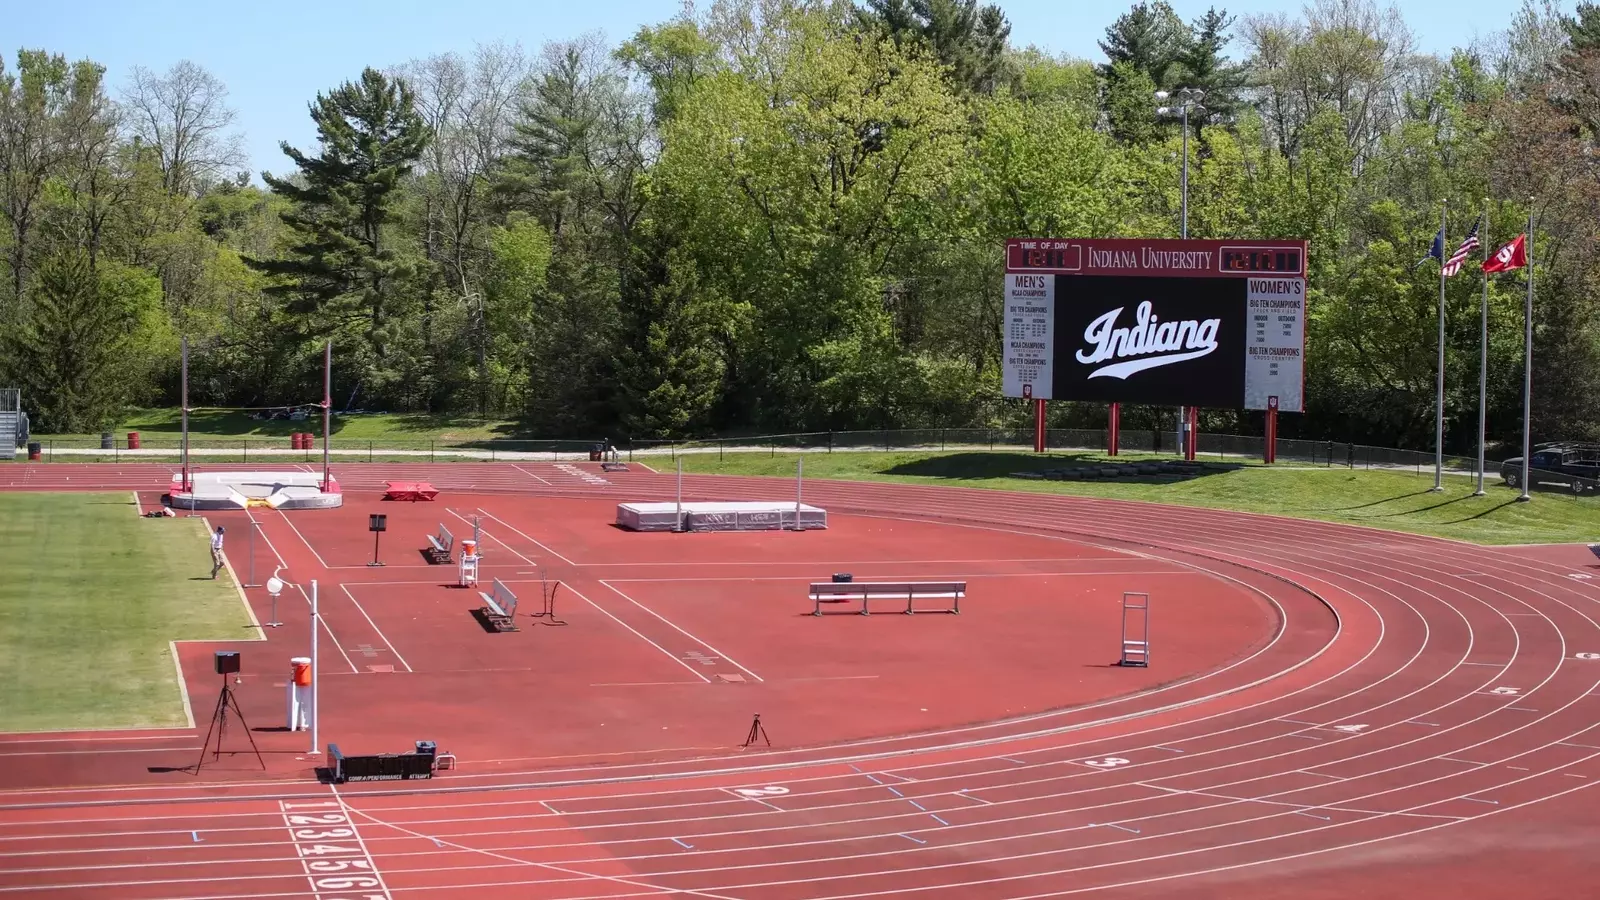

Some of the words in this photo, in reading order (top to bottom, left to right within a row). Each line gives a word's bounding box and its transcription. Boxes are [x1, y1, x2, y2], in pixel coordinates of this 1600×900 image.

[1020, 242, 1037, 250] TIME
[1041, 242, 1051, 250] OF
[1054, 242, 1069, 250] DAY
[1087, 246, 1138, 269] INDIANA
[1141, 246, 1213, 270] UNIVERSITY
[1015, 275, 1045, 288] MEN'S
[1250, 280, 1301, 295] WOMEN'S
[1250, 300, 1259, 308] BIG
[1260, 300, 1270, 308] TEN
[1270, 300, 1301, 309] CHAMPIONS
[1075, 300, 1221, 365] Indiana
[1022, 341, 1046, 350] CHAMPIONS
[1249, 346, 1258, 355] BIG
[1258, 347, 1269, 355] TEN
[1269, 347, 1300, 357] CHAMPIONS
[1024, 358, 1047, 366] CHAMPIONS
[1489, 686, 1522, 695] 5
[1084, 757, 1131, 767] 3
[734, 786, 790, 797] 2
[285, 801, 340, 810] 1
[288, 814, 347, 825] 2
[295, 828, 354, 839] 3
[302, 844, 362, 855] 4
[309, 860, 372, 871] 5
[316, 876, 379, 889] 6
